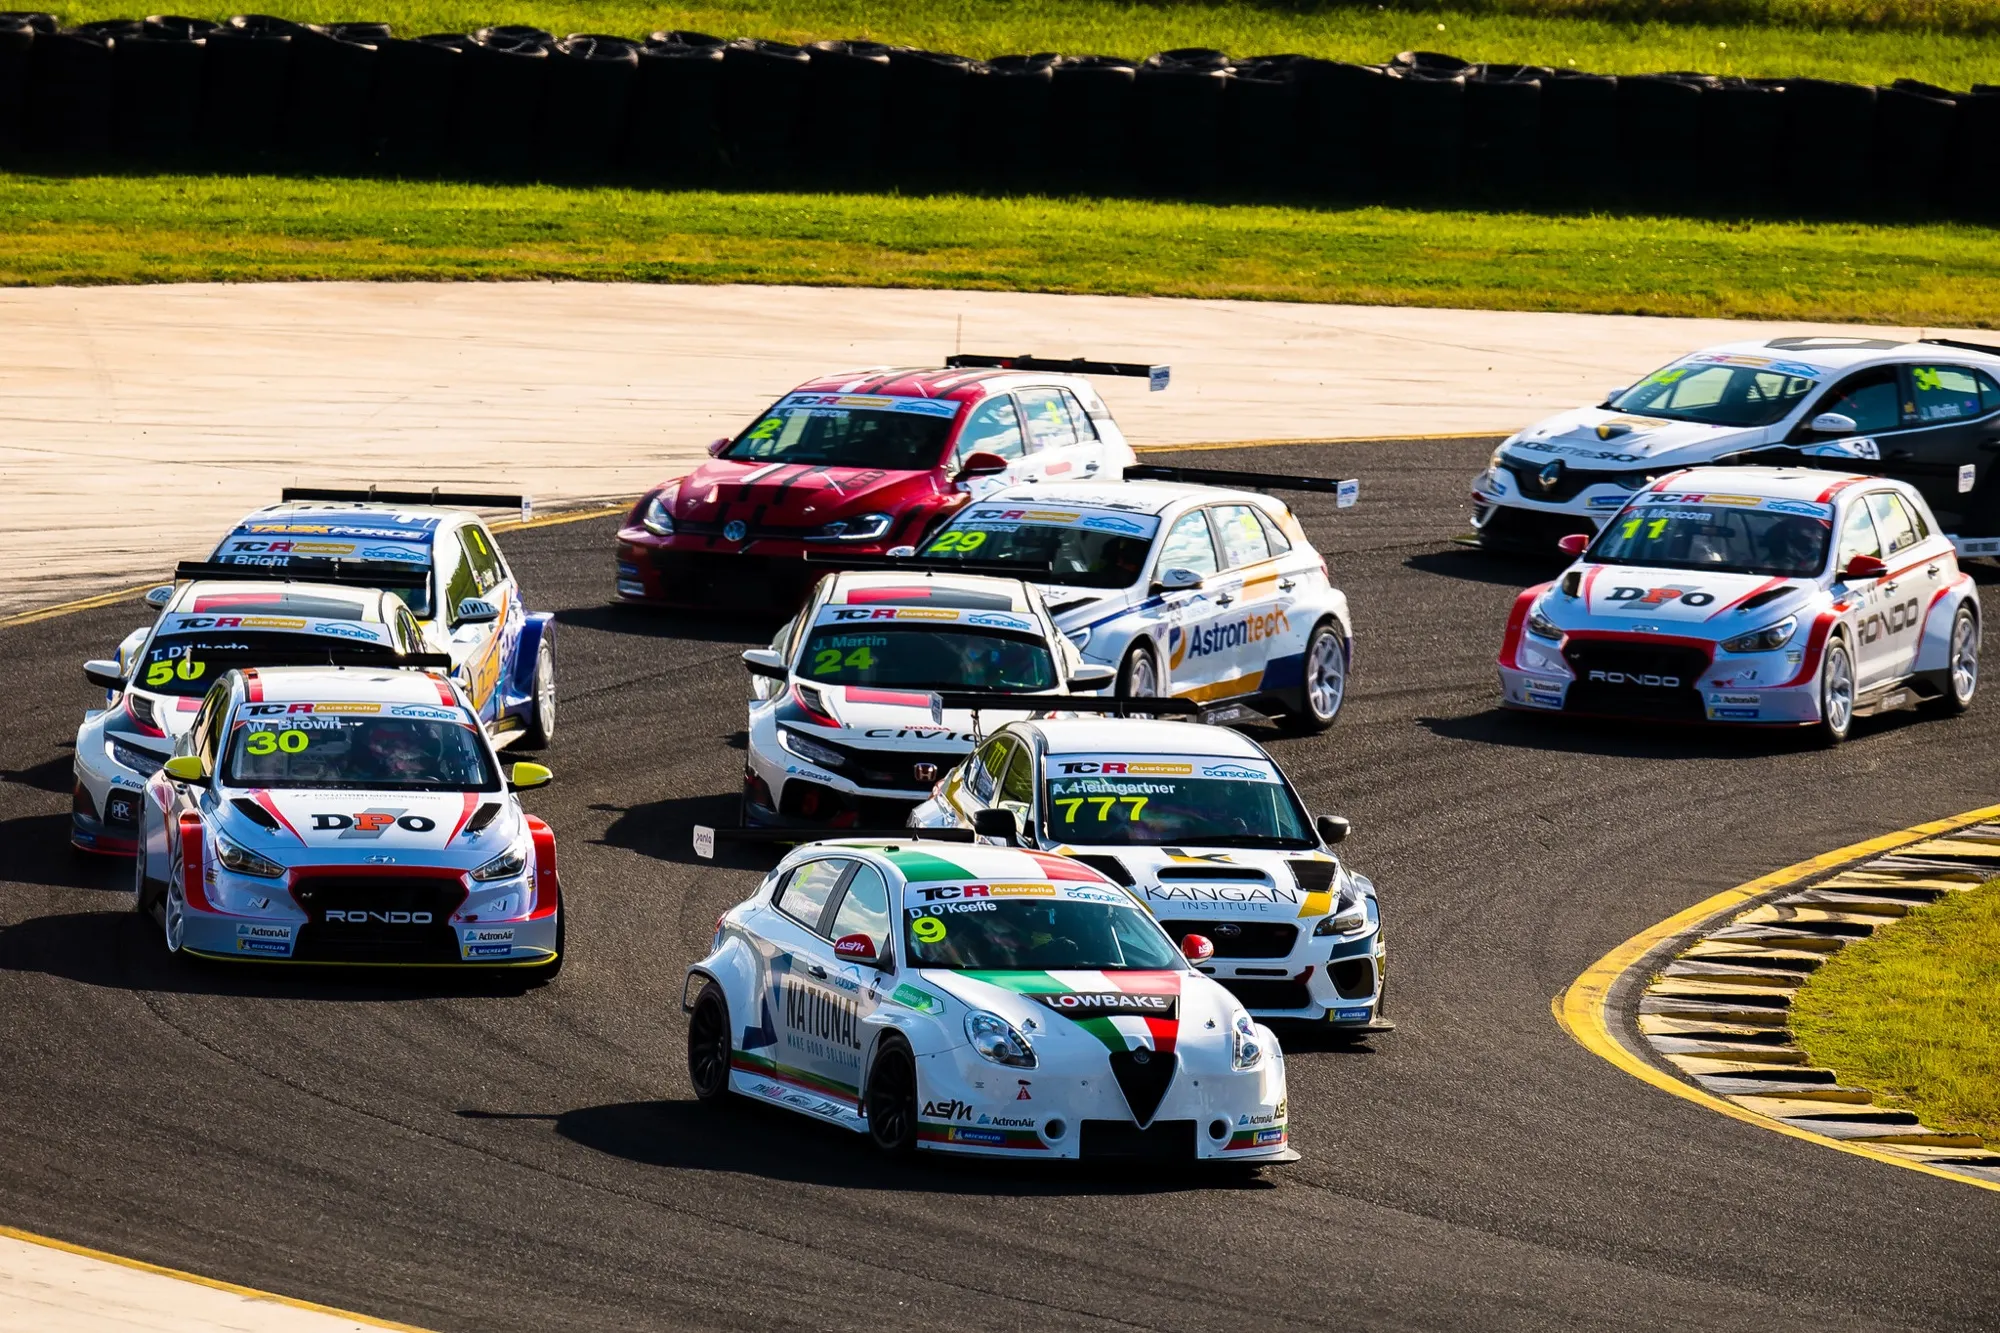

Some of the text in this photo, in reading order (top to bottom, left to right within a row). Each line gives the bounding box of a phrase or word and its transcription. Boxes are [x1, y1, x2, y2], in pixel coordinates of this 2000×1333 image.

[1913, 367, 1942, 391] 34
[788, 396, 842, 405] TCR
[750, 418, 783, 438] 2
[1648, 494, 1705, 503] TCR
[969, 510, 1026, 520] TCR
[1622, 518, 1669, 539] 11
[232, 542, 294, 552] TCR
[930, 532, 986, 552] 29
[234, 555, 289, 567] Bright
[362, 550, 425, 562] carsales
[832, 608, 958, 621] TCR Australia
[177, 617, 305, 629] TCR Australia
[968, 616, 1031, 630] carsales
[314, 626, 378, 641] carsales
[1187, 603, 1290, 660] Astrontech
[813, 635, 887, 650] J. Martin
[151, 649, 163, 661] T.
[813, 647, 873, 675] 24
[146, 659, 205, 686] 50
[1589, 670, 1680, 687] RONDO
[245, 703, 380, 716] TCR Australia
[391, 708, 458, 721] carsales
[247, 719, 342, 734] W. Brown
[247, 730, 309, 756] 30
[798, 769, 833, 783] ActronAir
[1058, 762, 1191, 775] TCR Australia
[1202, 767, 1267, 780] carsales
[1053, 782, 1175, 797] A. Heimgartner
[1055, 797, 1149, 824] 777
[917, 885, 1054, 900] TCR Australia
[1066, 889, 1129, 904] carsales
[1144, 885, 1298, 904] KANGAN
[909, 901, 998, 919] D. O'Keeffe
[1182, 902, 1268, 912] INSTITUTE
[326, 910, 432, 923] RONDO
[250, 928, 290, 937] ActronAir
[479, 931, 514, 940] ActronAir
[912, 916, 947, 943] 9
[252, 943, 286, 951] MICHELIN
[838, 940, 865, 952] ASM
[1045, 993, 1167, 1008] LOWBAKE
[786, 980, 861, 1050] NATIONAL
[787, 1032, 804, 1052] MAKE
[807, 1039, 823, 1057] GOOD
[922, 1099, 973, 1121] ASM
[1274, 1099, 1286, 1119] AS
[992, 1117, 1035, 1128] ActronAir
[964, 1132, 1000, 1140] MICHELIN
